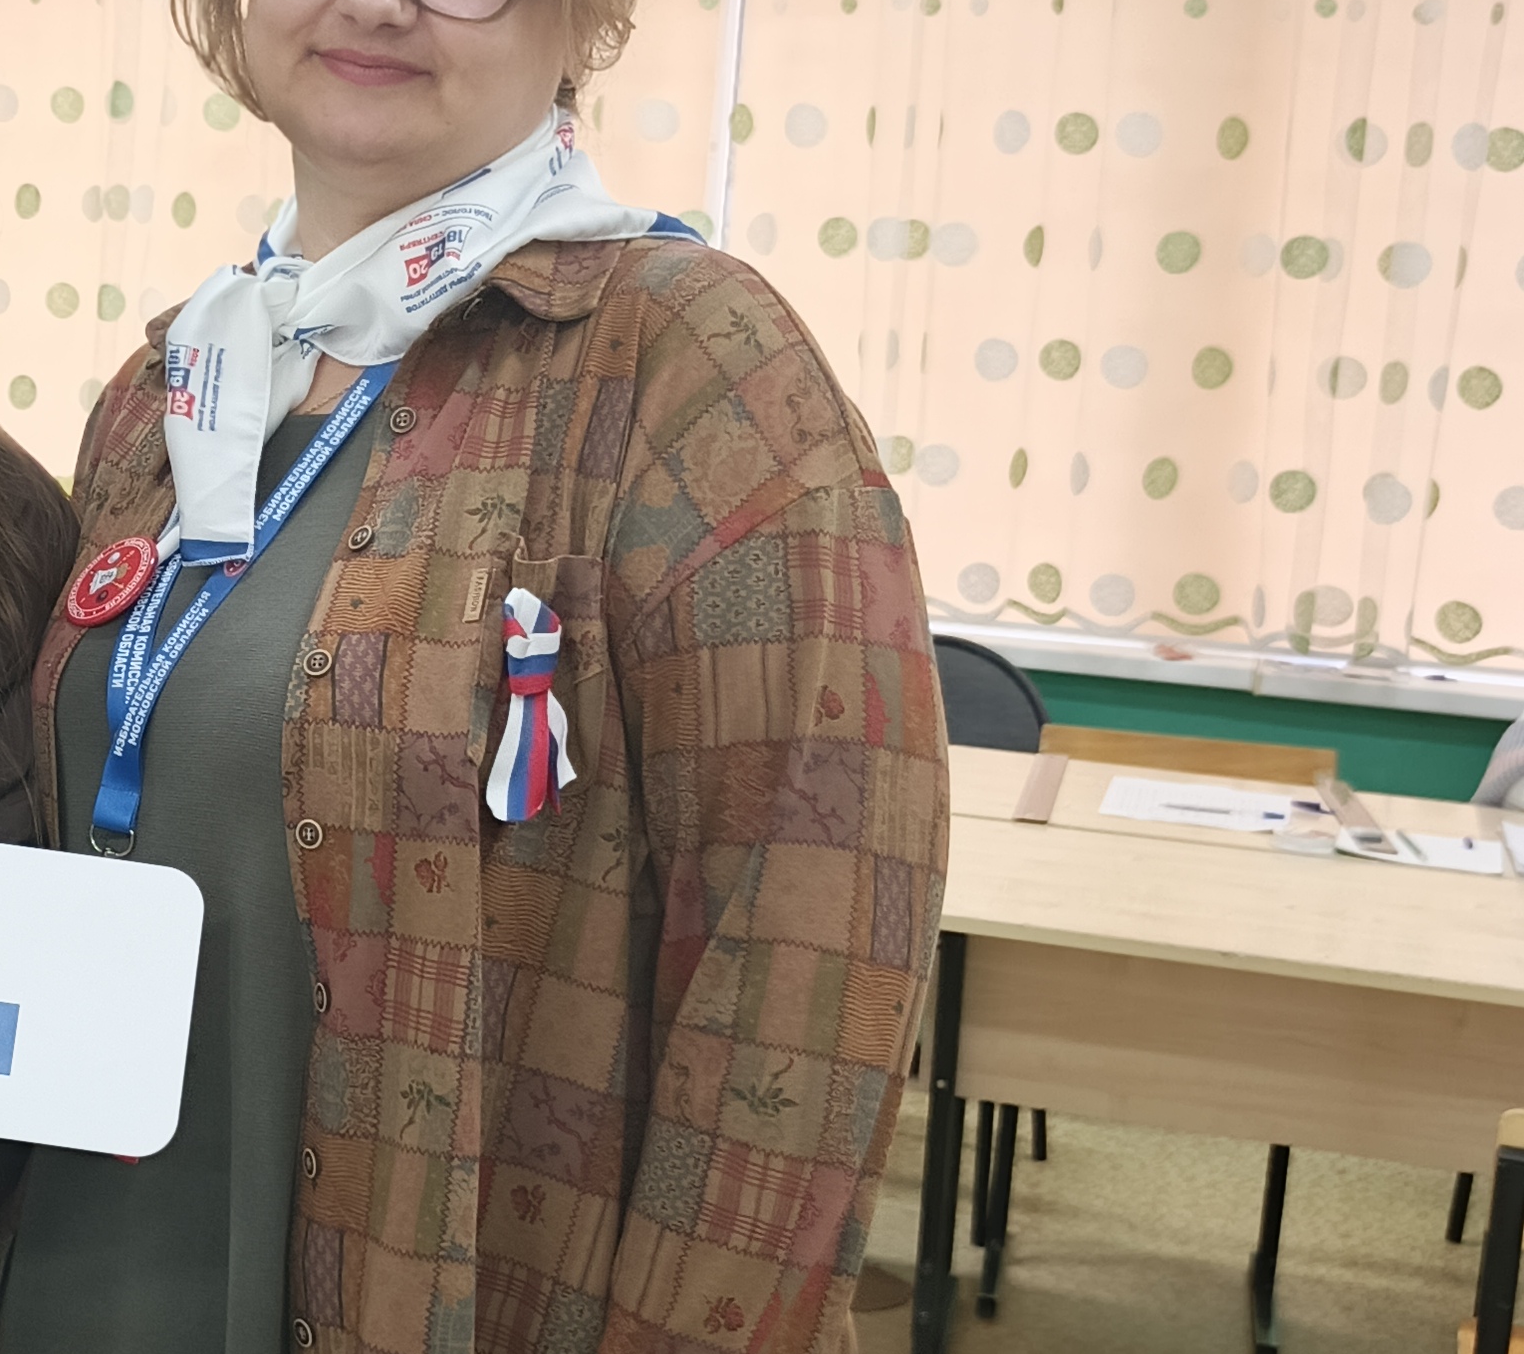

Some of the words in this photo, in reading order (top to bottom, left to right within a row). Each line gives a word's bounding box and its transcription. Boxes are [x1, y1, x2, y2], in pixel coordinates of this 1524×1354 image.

[447, 229, 464, 243] 18
[430, 243, 443, 259] 19
[408, 258, 428, 279] 20
[168, 348, 181, 365] 18
[169, 370, 185, 387] 19
[172, 390, 190, 414] 20
[254, 440, 324, 530] ИЗБИРАТЕЛЬНАЯ
[321, 378, 370, 440] КОМИССИЯ
[272, 446, 333, 522] МОСКОВСКОЙ
[329, 395, 372, 446] ОБЛАСТИ
[111, 633, 134, 688] ОБЛАСТИ
[113, 653, 166, 757] ИЗБИРАТЕЛЬНАЯ
[161, 590, 211, 653] КОМИССИЯ
[128, 659, 173, 746] МОСКОВСКОЙ
[168, 607, 210, 660] ОБЛАСТИ
